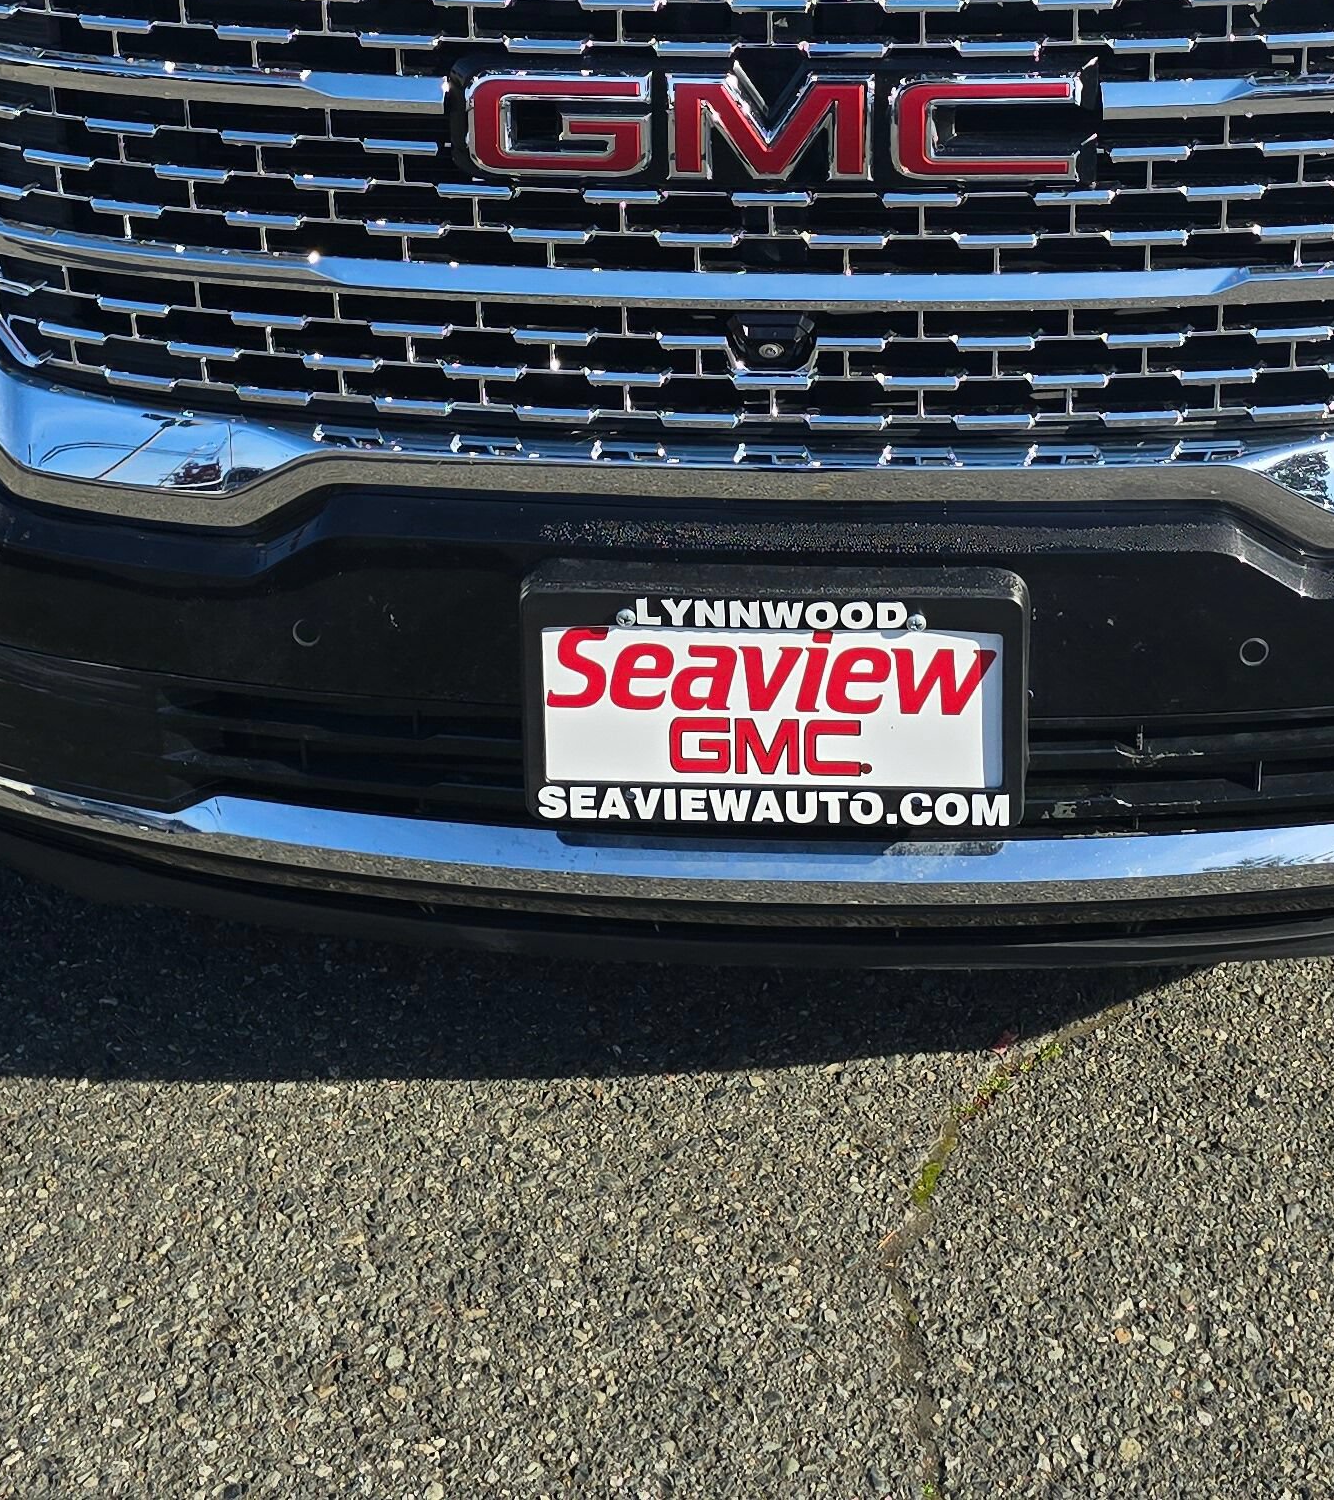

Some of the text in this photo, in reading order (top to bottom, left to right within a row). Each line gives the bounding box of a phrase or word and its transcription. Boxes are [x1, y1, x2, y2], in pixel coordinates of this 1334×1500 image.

[468, 70, 1082, 181] GMC
[635, 597, 908, 630] LYNNWOOD
[546, 626, 997, 715] Seaview
[537, 786, 1010, 827] SEAVIEWAUTO.COM
